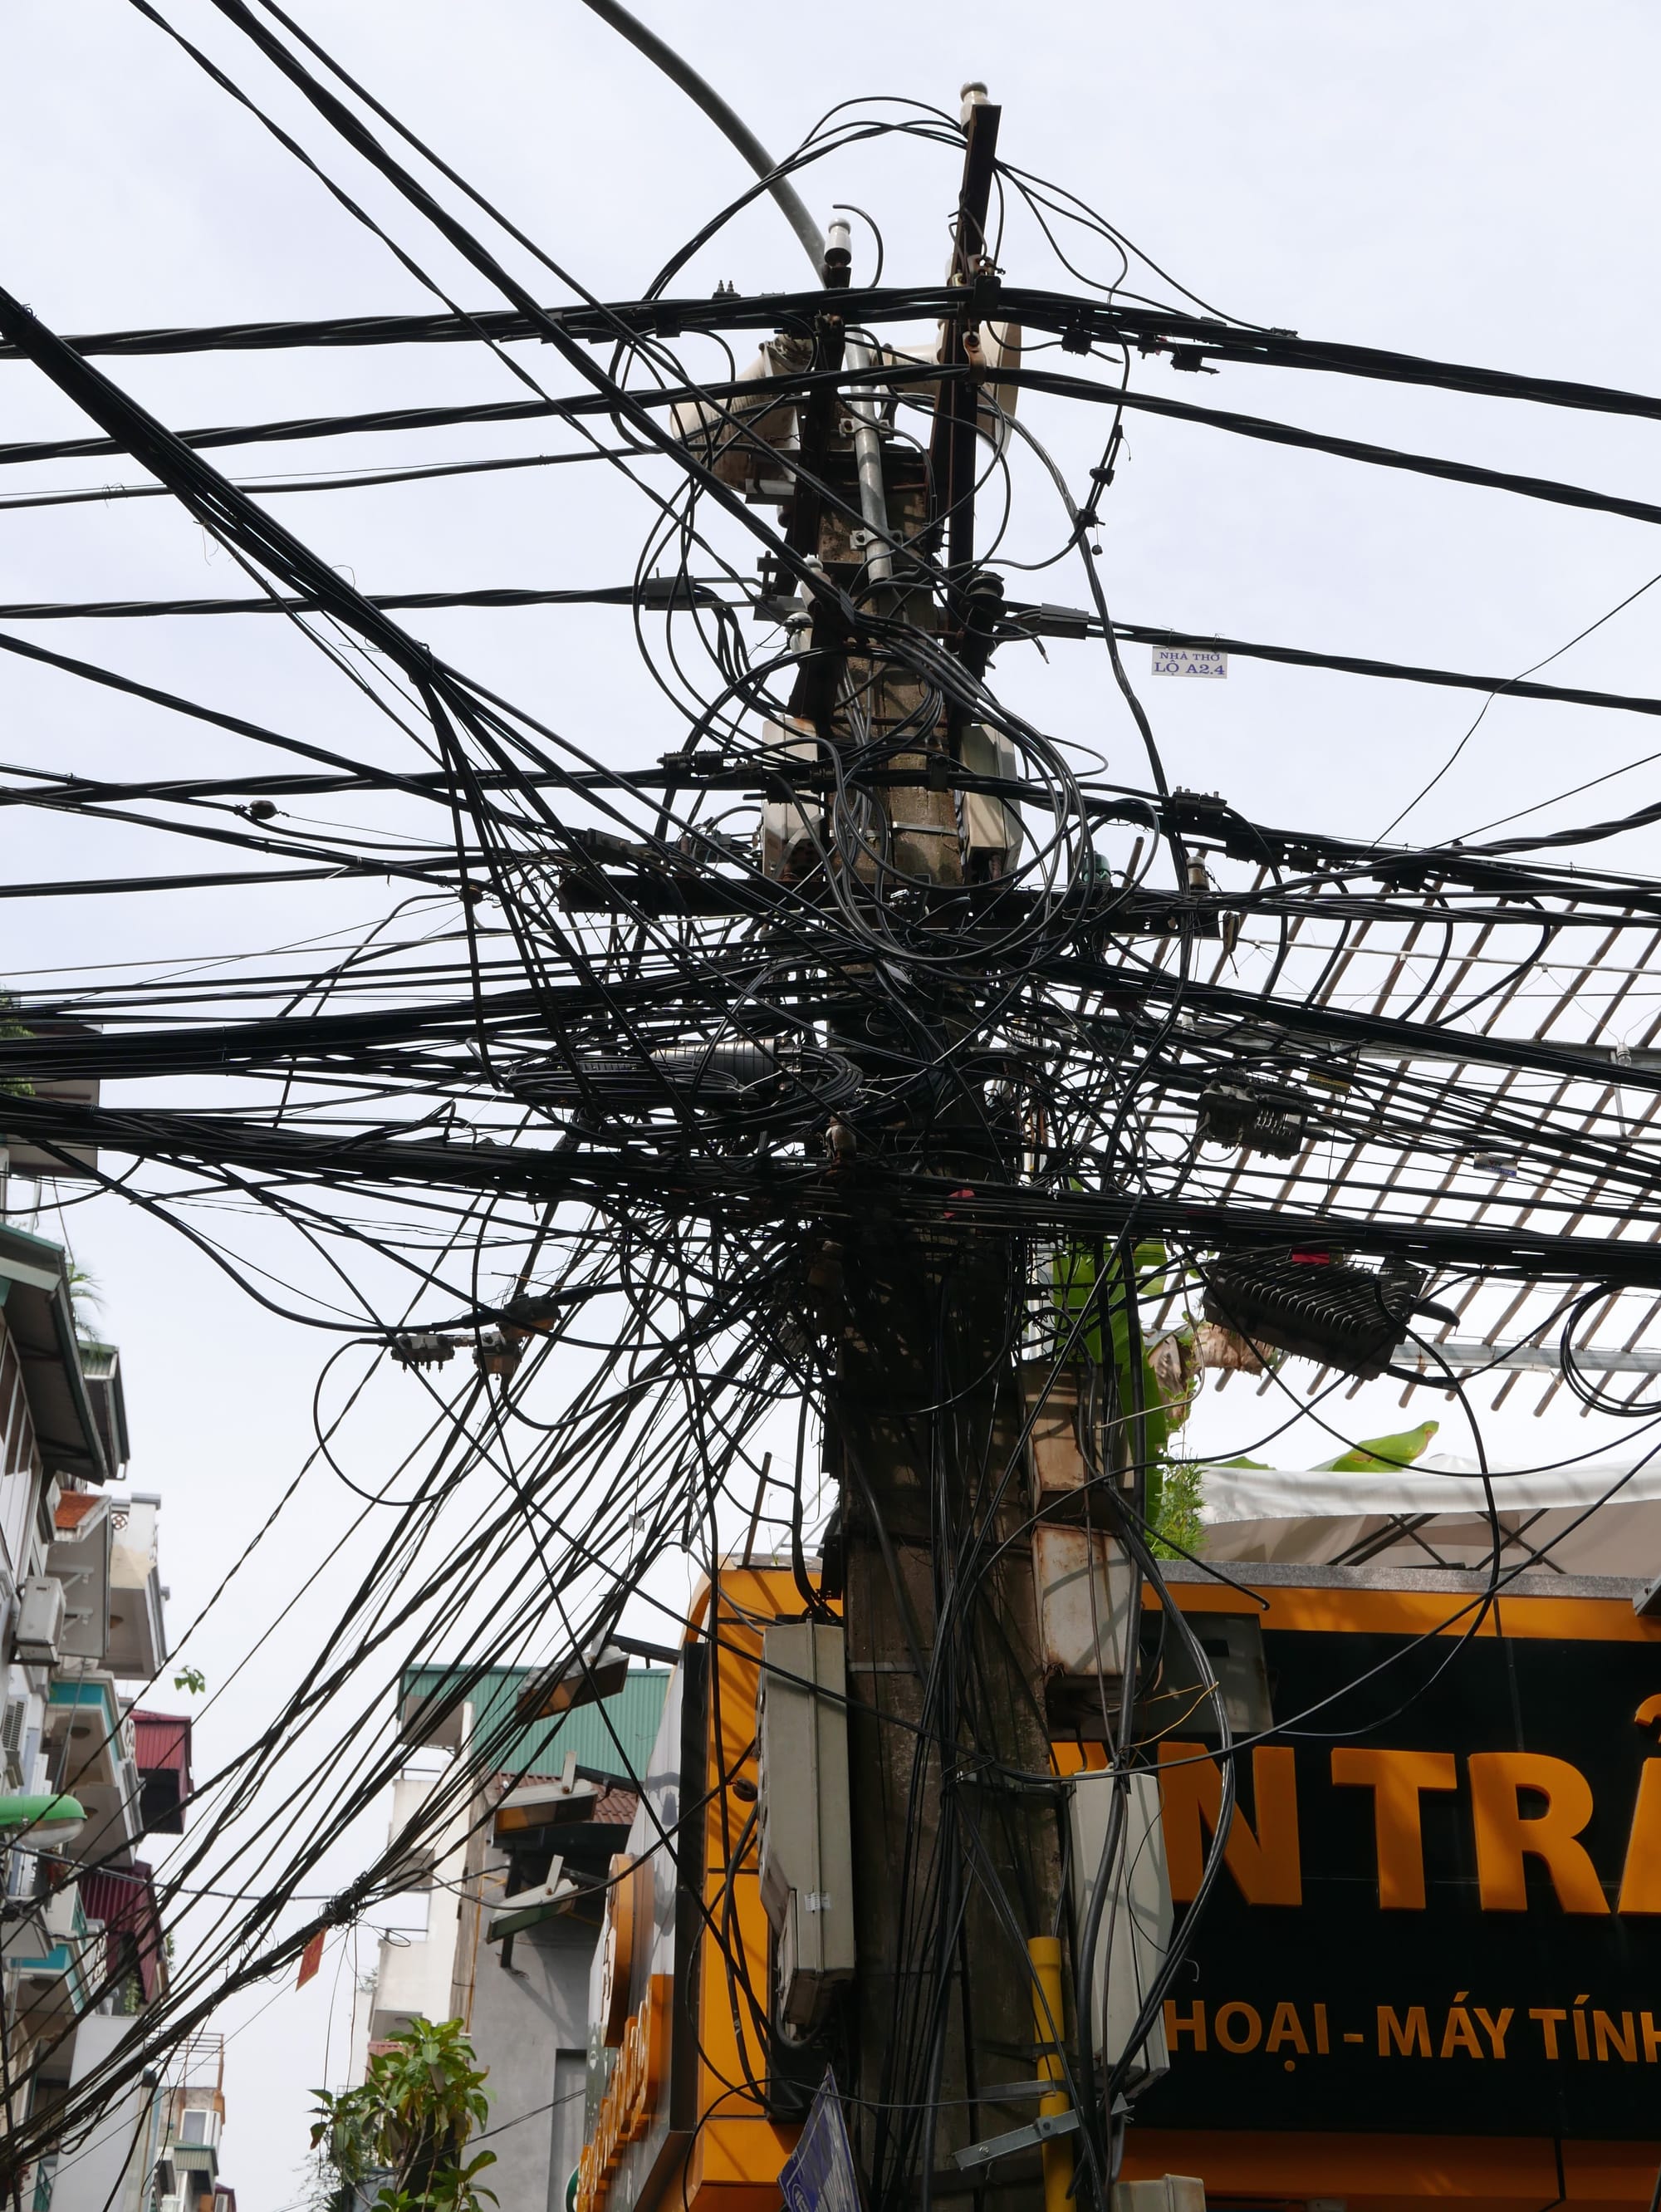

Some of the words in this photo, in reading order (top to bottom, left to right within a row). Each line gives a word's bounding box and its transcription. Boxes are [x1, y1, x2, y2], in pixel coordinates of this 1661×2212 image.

[1159, 650, 1188, 660] NHÀ
[1154, 659, 1179, 675] LỘ
[1184, 663, 1225, 675] A2.4
[1377, 1991, 1515, 2060] MÁY
